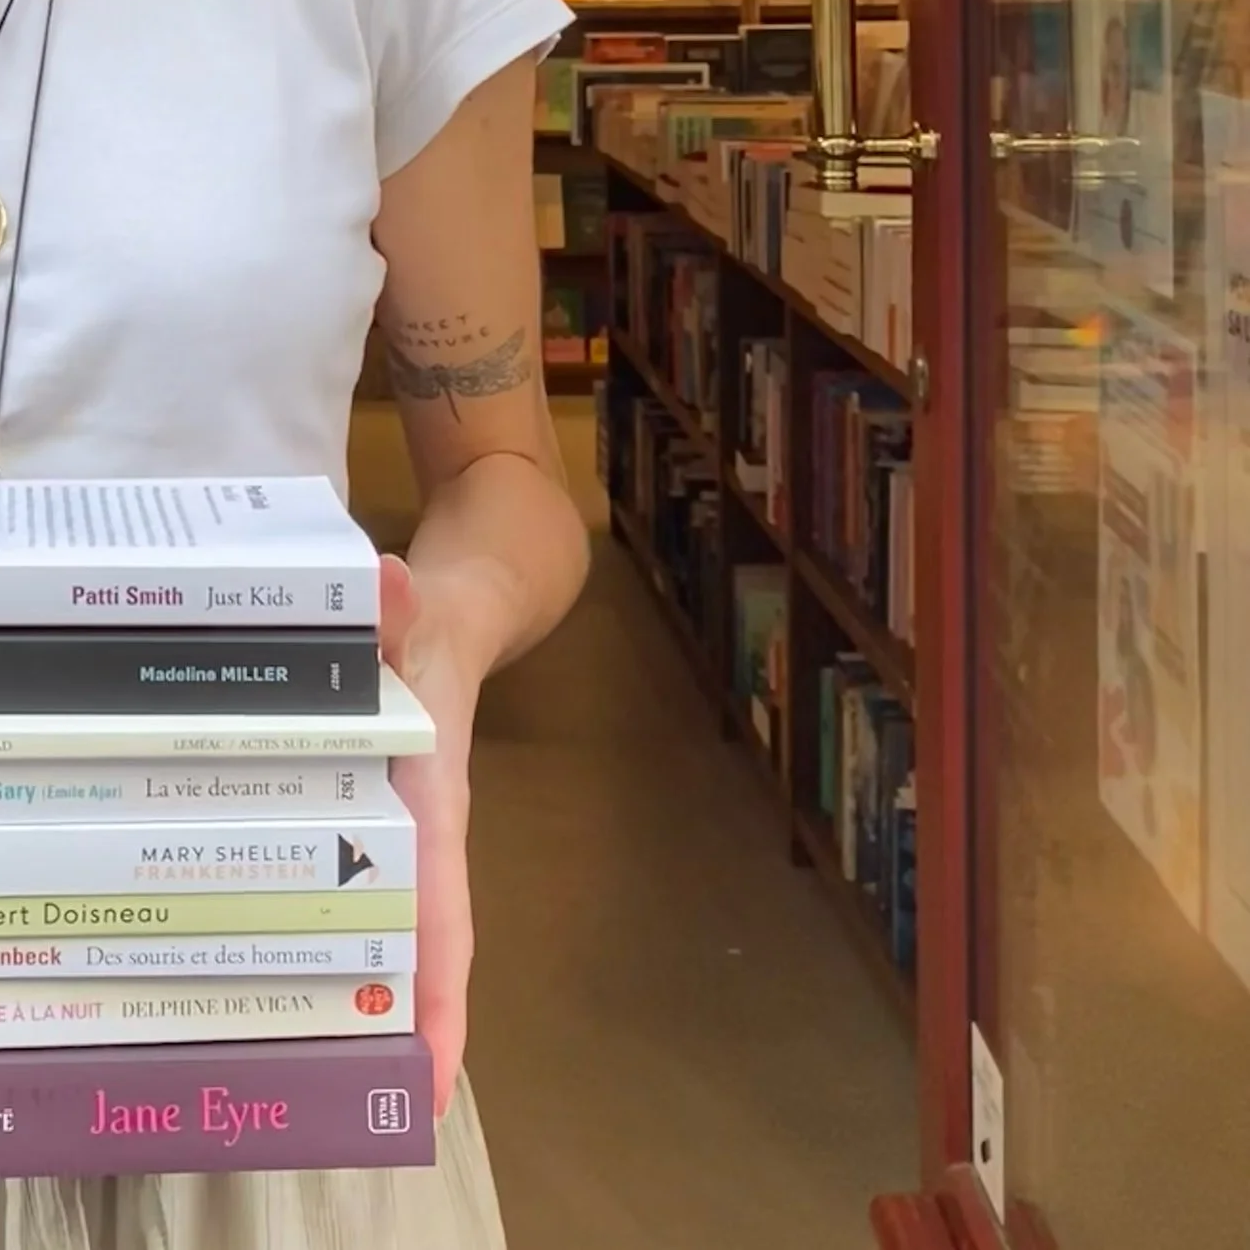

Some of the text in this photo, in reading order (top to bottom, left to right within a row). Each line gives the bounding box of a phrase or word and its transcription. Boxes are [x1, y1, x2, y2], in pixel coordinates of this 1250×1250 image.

[72, 585, 120, 607] Patti
[126, 585, 184, 607] Smith
[205, 587, 243, 611] Just
[250, 586, 294, 607] Kids
[140, 666, 217, 682] Madeline
[221, 667, 289, 682] MILLER
[238, 738, 280, 750] ACTES
[283, 738, 311, 750] SUD
[322, 737, 374, 750] PAPIERS
[146, 778, 169, 798] La
[174, 777, 203, 797] vie
[208, 776, 271, 797] devant
[277, 776, 304, 796] soi
[141, 845, 318, 863] MARY SHELLEY
[134, 864, 316, 881] FRANKENSTEIN
[44, 901, 169, 924] Doisneau
[86, 946, 124, 967] Des
[128, 945, 186, 966] souris
[190, 949, 208, 965] et
[214, 944, 246, 964] des
[251, 943, 333, 964] hommes
[12, 1001, 26, 1022] À
[32, 1004, 56, 1021] LA
[61, 1002, 105, 1021] NUIT
[121, 999, 220, 1018] DELPHINE
[225, 997, 252, 1015] DE
[256, 995, 316, 1013] VIGAN
[90, 1089, 183, 1135] Jane
[200, 1086, 291, 1147] Eyre
